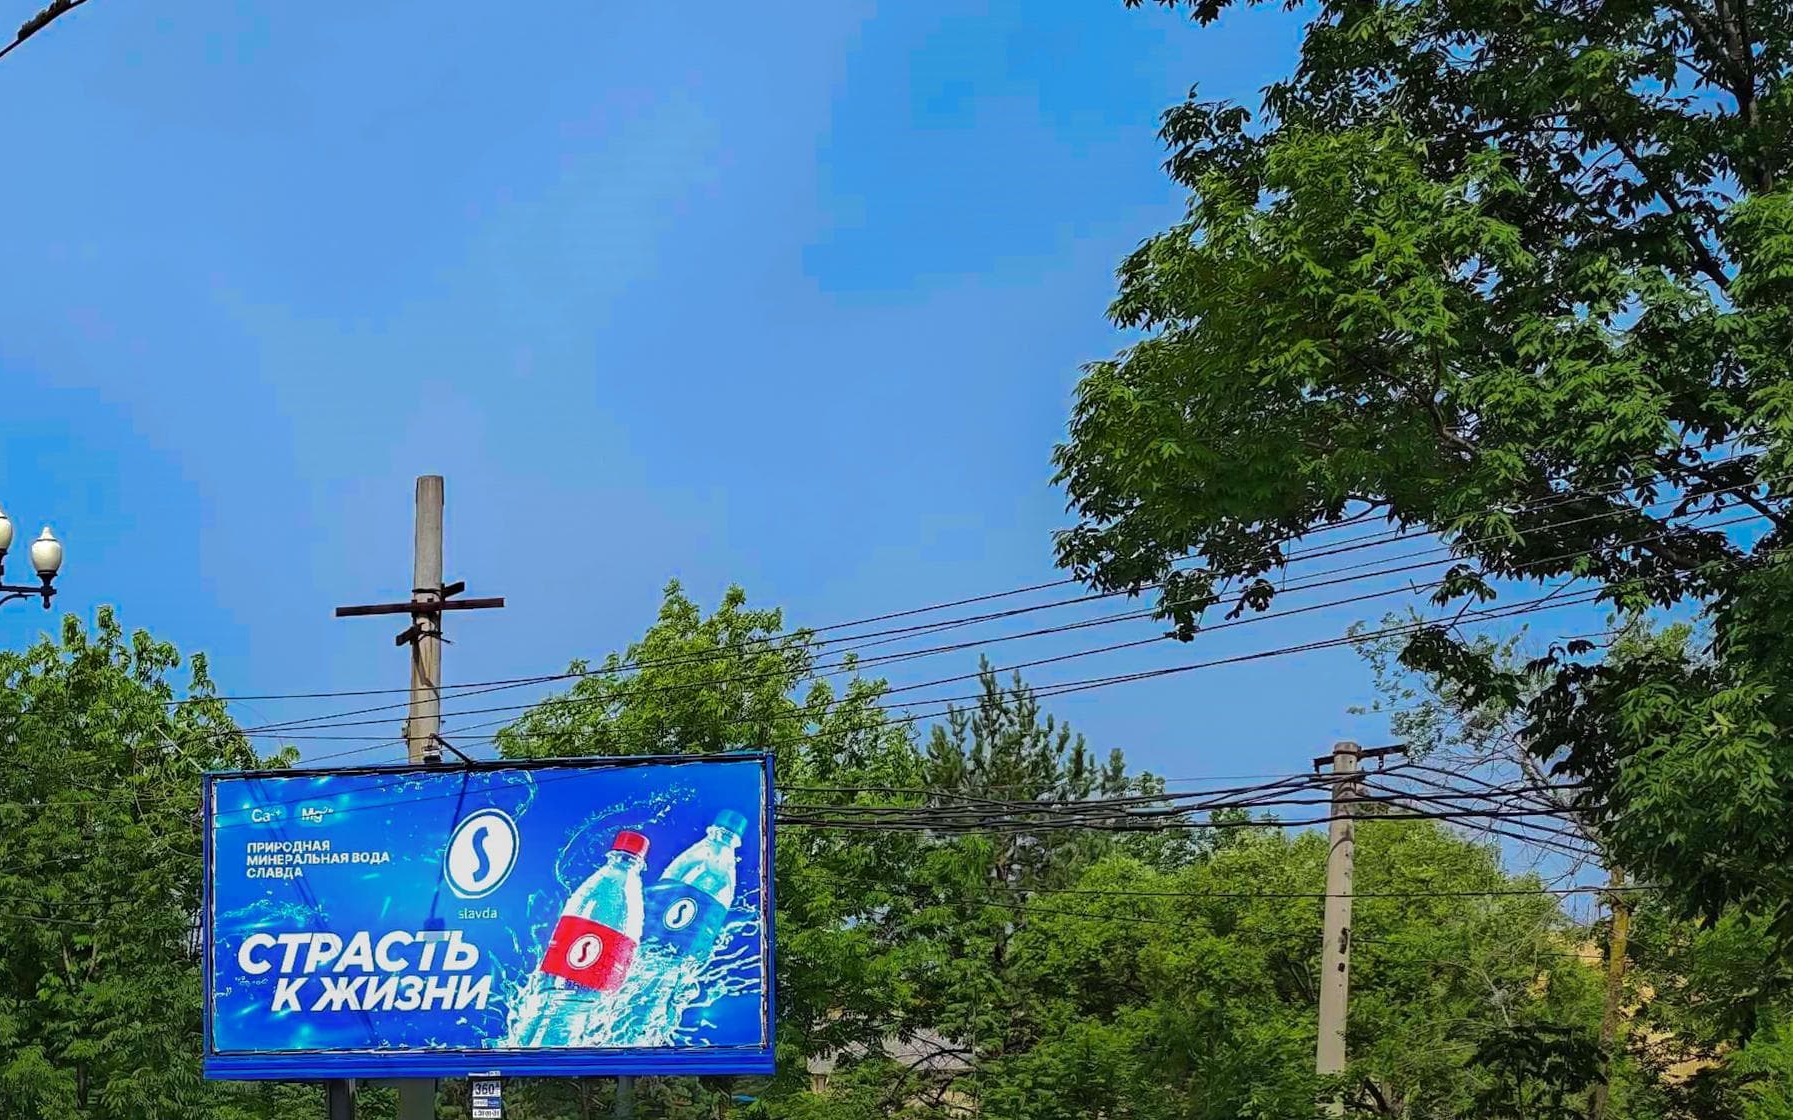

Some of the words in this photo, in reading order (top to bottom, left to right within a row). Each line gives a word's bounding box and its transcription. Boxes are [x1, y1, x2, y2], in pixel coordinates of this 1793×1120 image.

[247, 840, 330, 854] ПРИРОДНАЯ
[246, 853, 348, 866] МИНЕРАЛЬНАЯ
[351, 852, 390, 865] ВОДА
[246, 867, 303, 879] СЛАВДА
[458, 908, 498, 919] slavda
[238, 930, 479, 975] СТРАСТЬ
[271, 977, 308, 1012] К
[310, 975, 492, 1011] ЖИЗНИ
